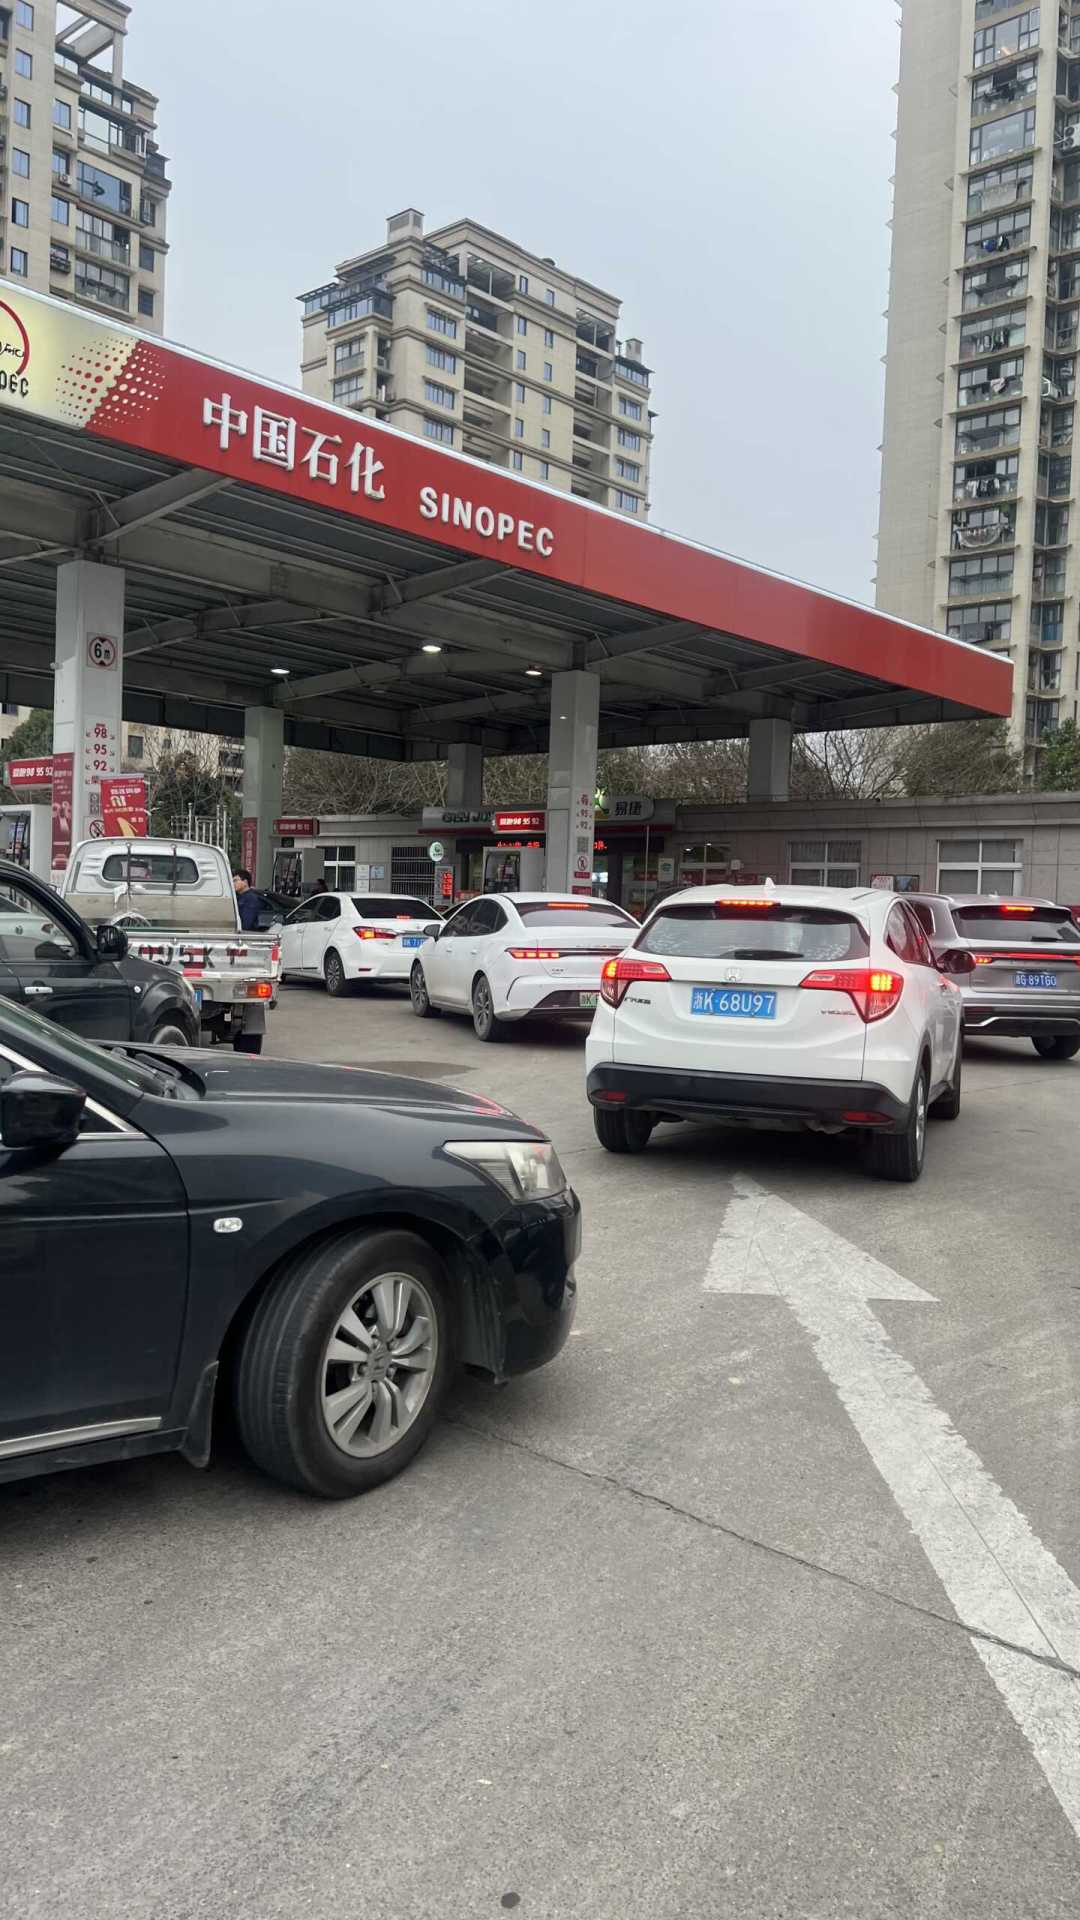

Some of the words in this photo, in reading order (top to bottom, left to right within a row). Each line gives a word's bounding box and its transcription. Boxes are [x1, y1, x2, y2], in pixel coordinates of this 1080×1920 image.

[203, 393, 385, 499] 中国石化
[420, 487, 554, 556] SINOPEC
[94, 728, 107, 738] 98
[94, 744, 107, 755] 95
[36, 766, 44, 776] 95
[93, 760, 107, 771] 92
